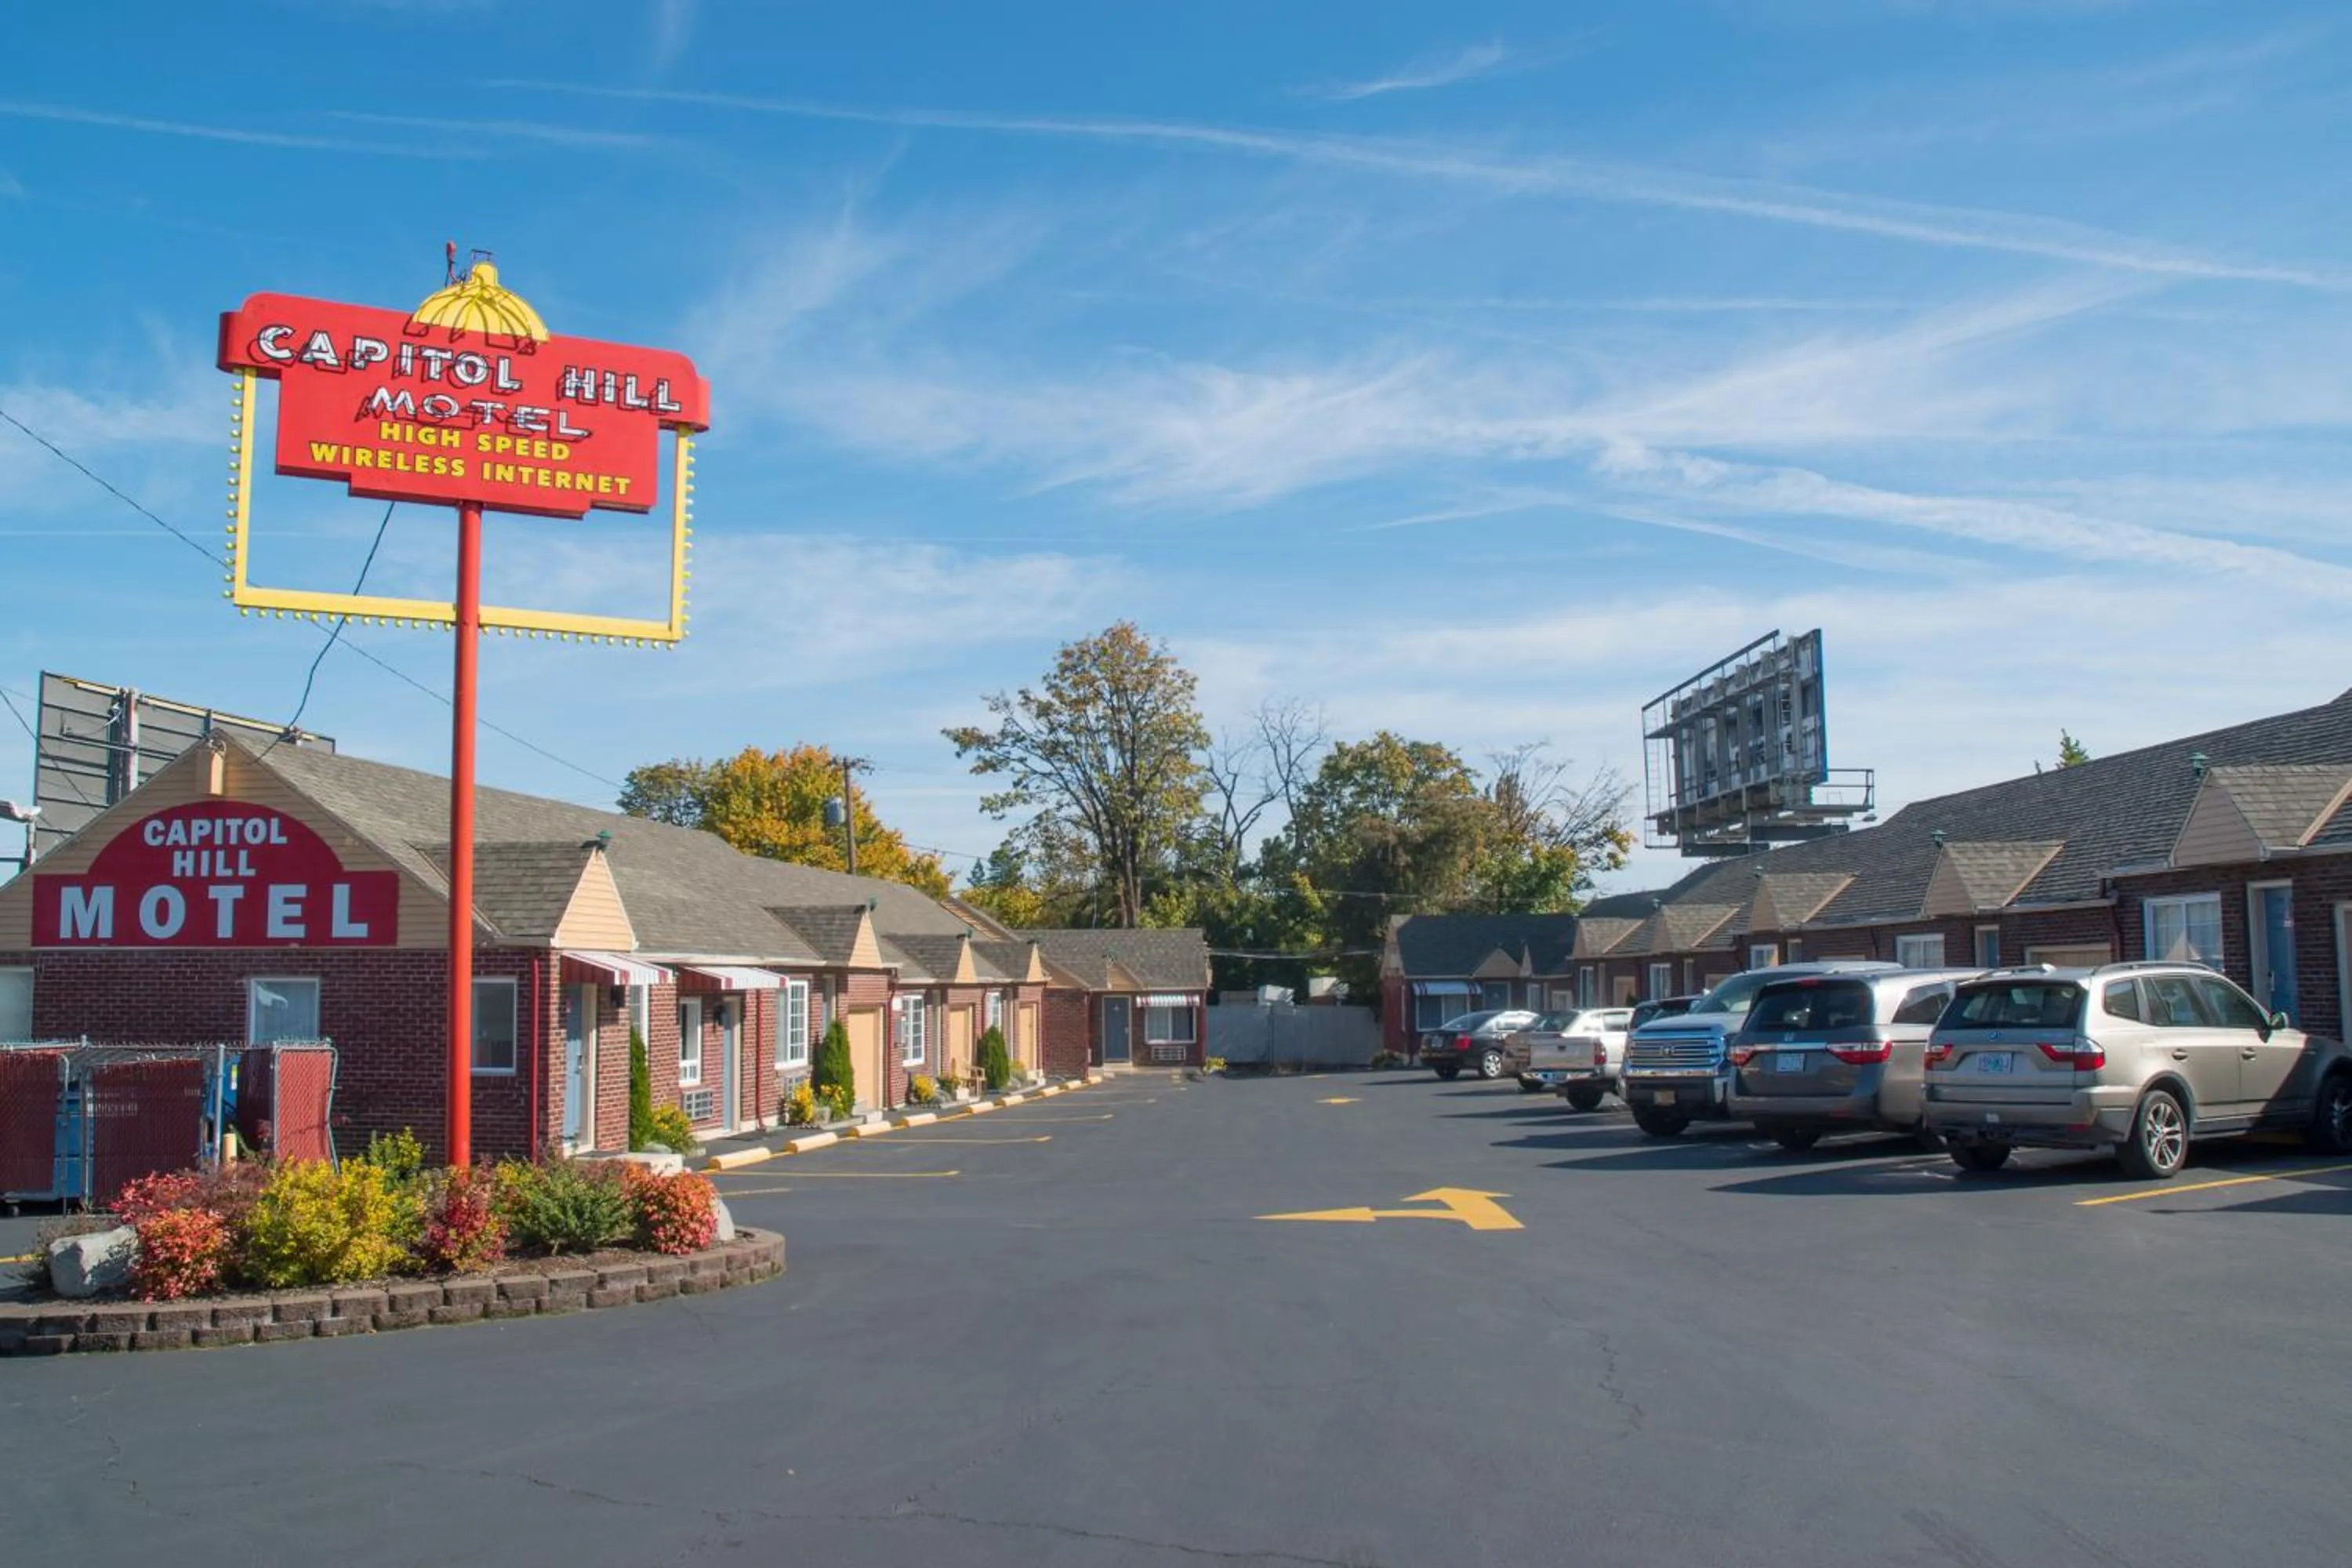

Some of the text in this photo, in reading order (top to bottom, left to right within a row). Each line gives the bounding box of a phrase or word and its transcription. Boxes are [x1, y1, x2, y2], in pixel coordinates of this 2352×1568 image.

[258, 325, 681, 412] CAPITOL HILL
[368, 387, 591, 437] MOTEL
[379, 422, 571, 461] HIGH SPEED
[309, 442, 630, 495] WIRELESS INTERNET
[144, 818, 287, 846] CAPITOL
[173, 850, 256, 877] HILL
[60, 884, 368, 939] MOTEL
